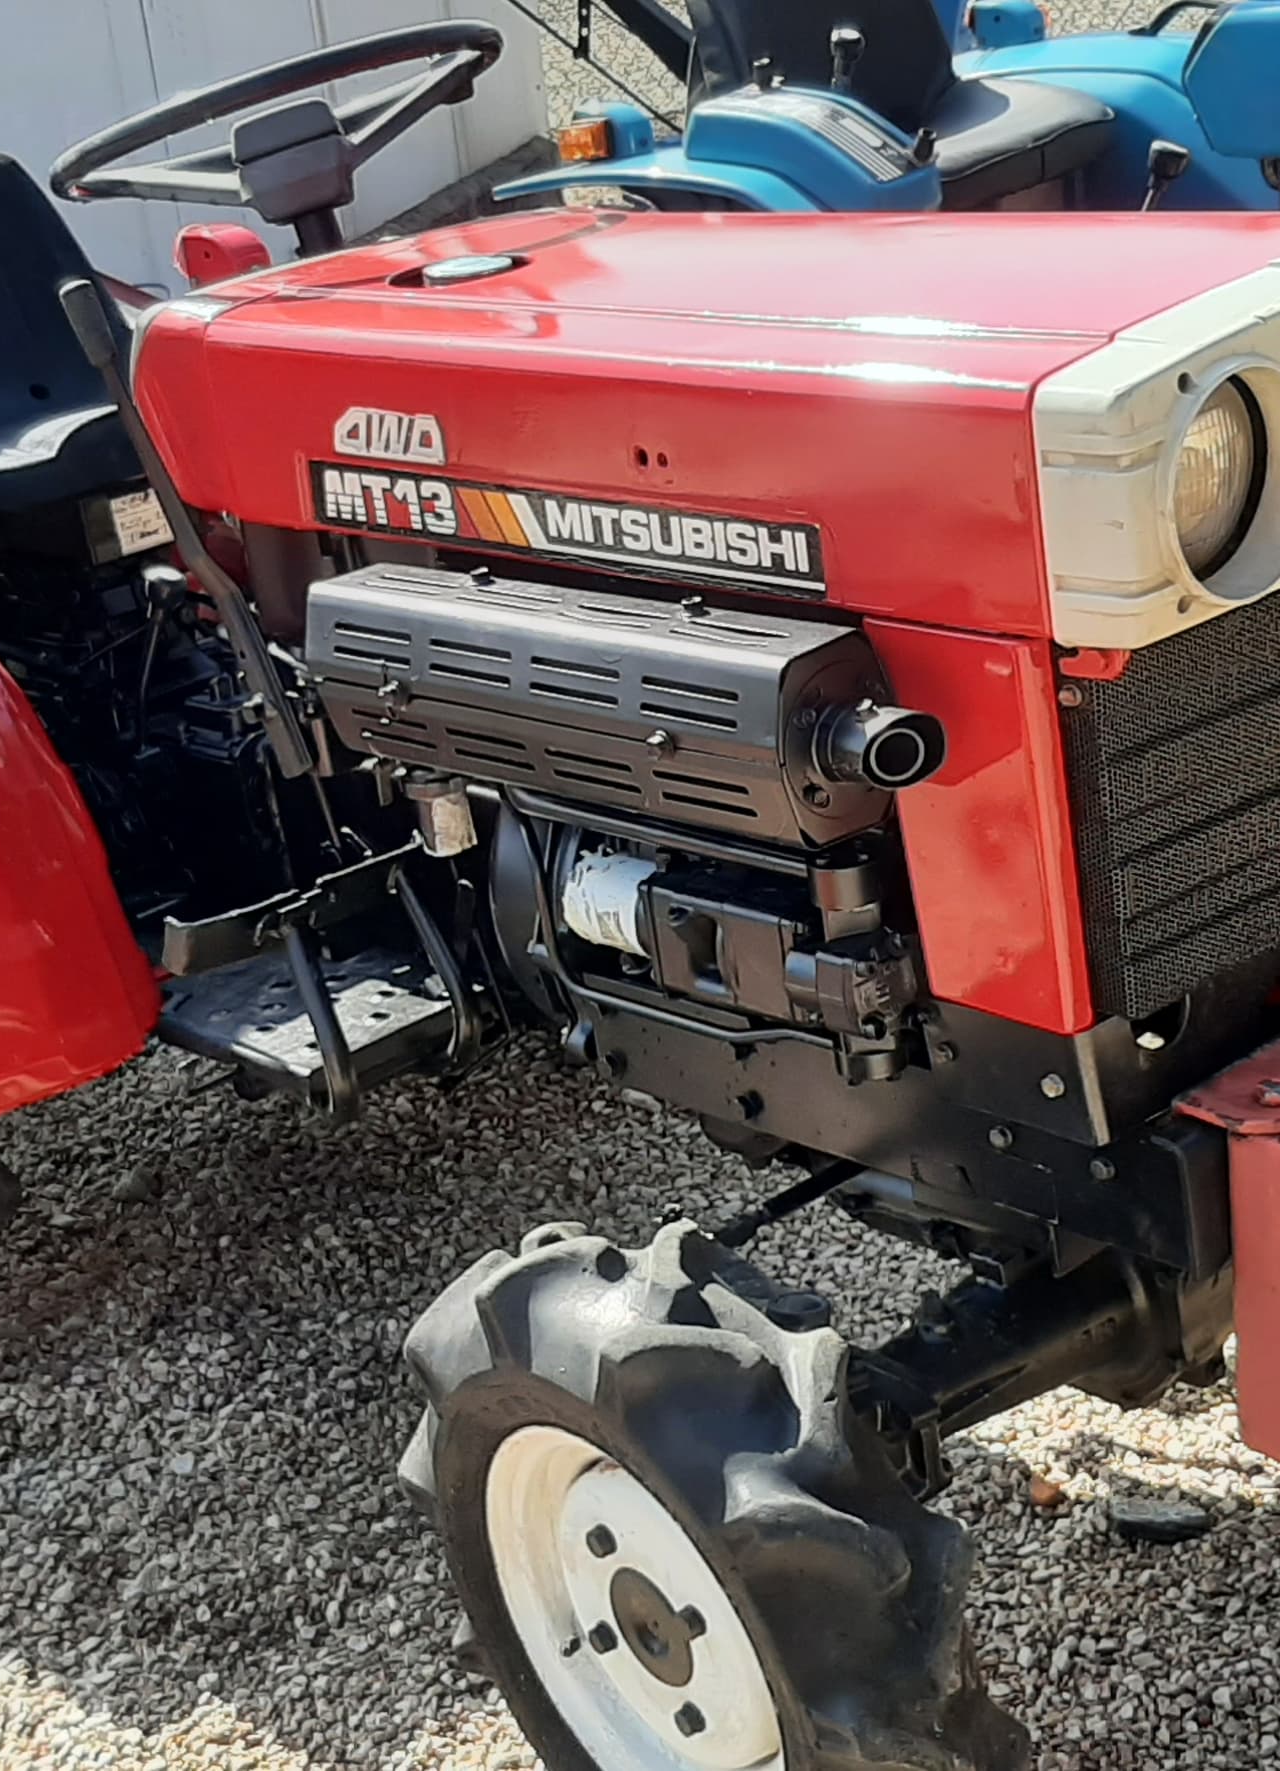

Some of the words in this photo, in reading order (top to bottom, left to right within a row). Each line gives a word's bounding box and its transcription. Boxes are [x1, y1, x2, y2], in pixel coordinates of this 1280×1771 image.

[334, 406, 446, 466] 4WD
[324, 468, 458, 536] MT13
[544, 499, 810, 573] MITSUBISHI
